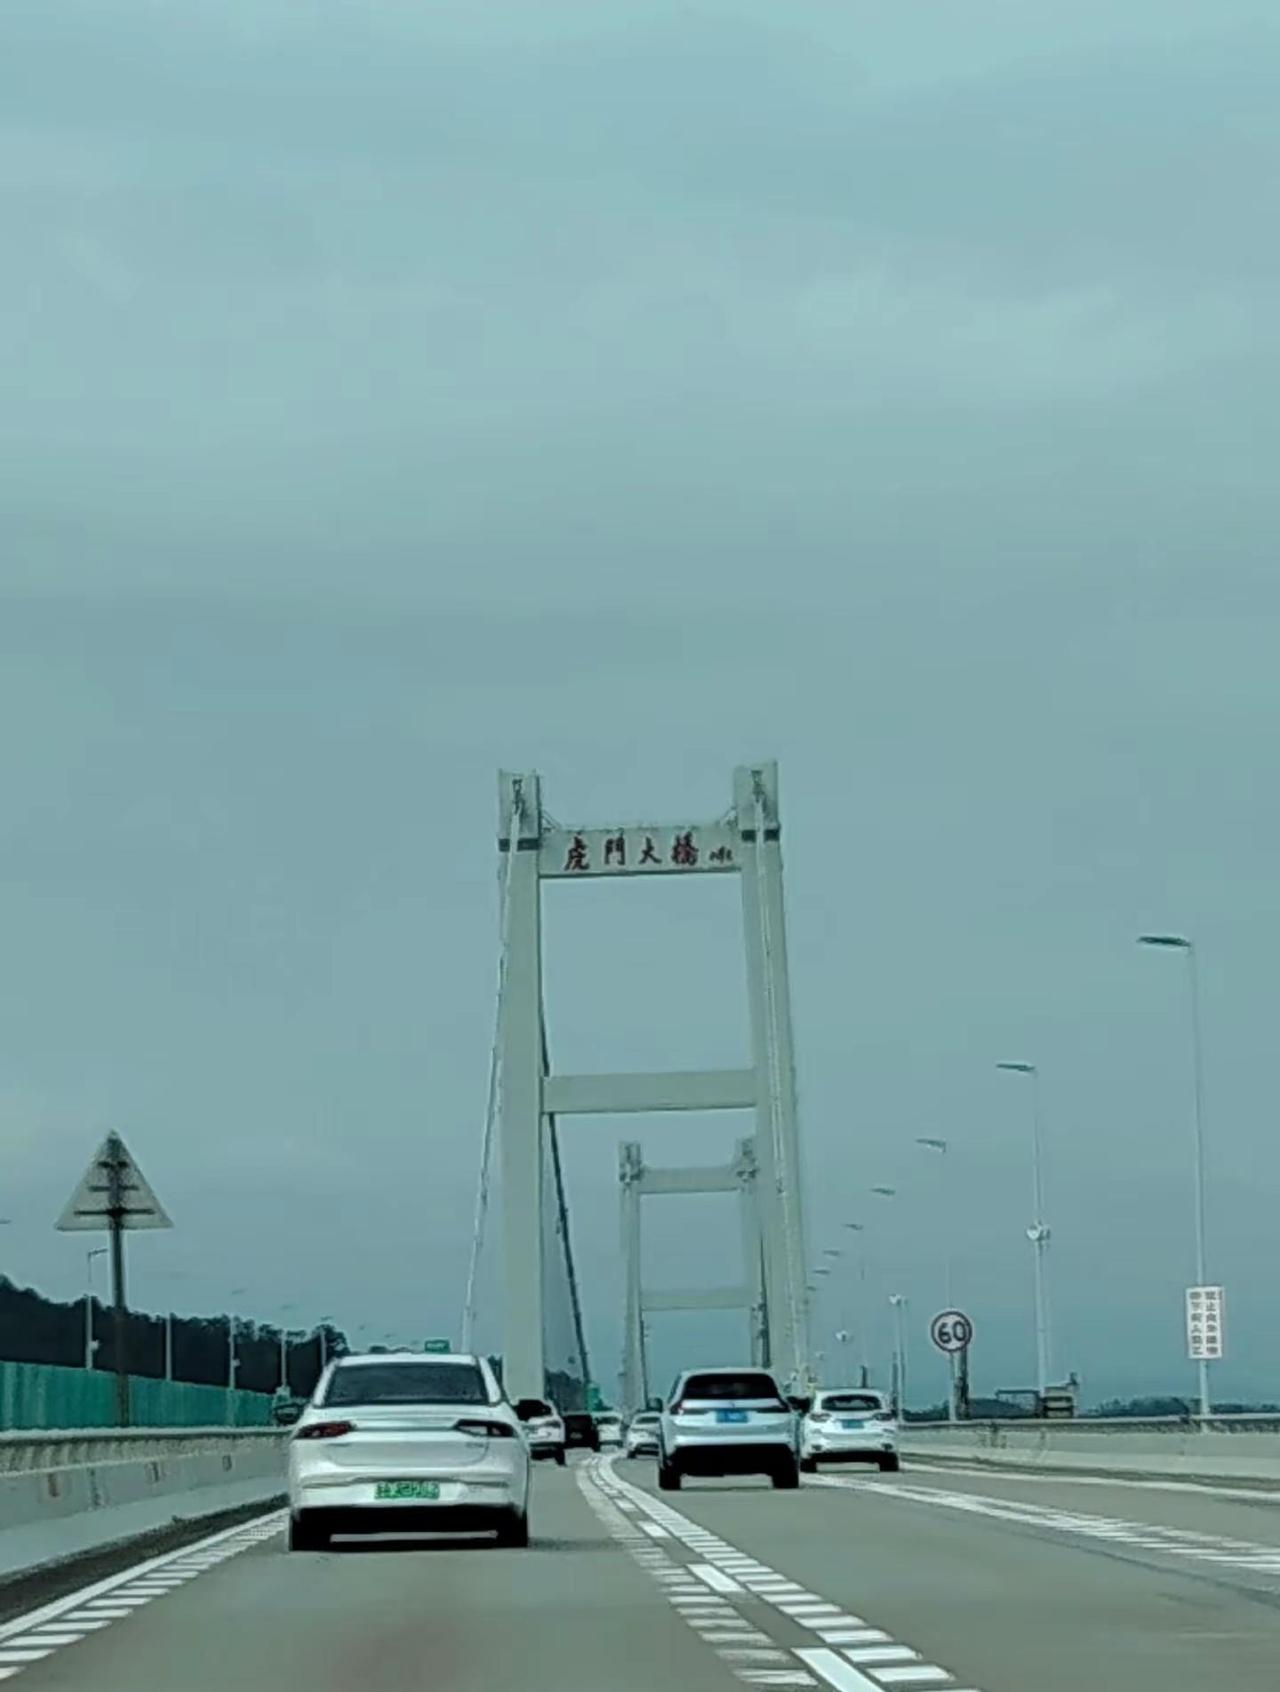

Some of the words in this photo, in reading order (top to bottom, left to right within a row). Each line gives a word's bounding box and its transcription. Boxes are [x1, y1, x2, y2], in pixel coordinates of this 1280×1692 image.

[564, 831, 699, 871] 虎門大橋
[938, 1320, 967, 1344] 60
